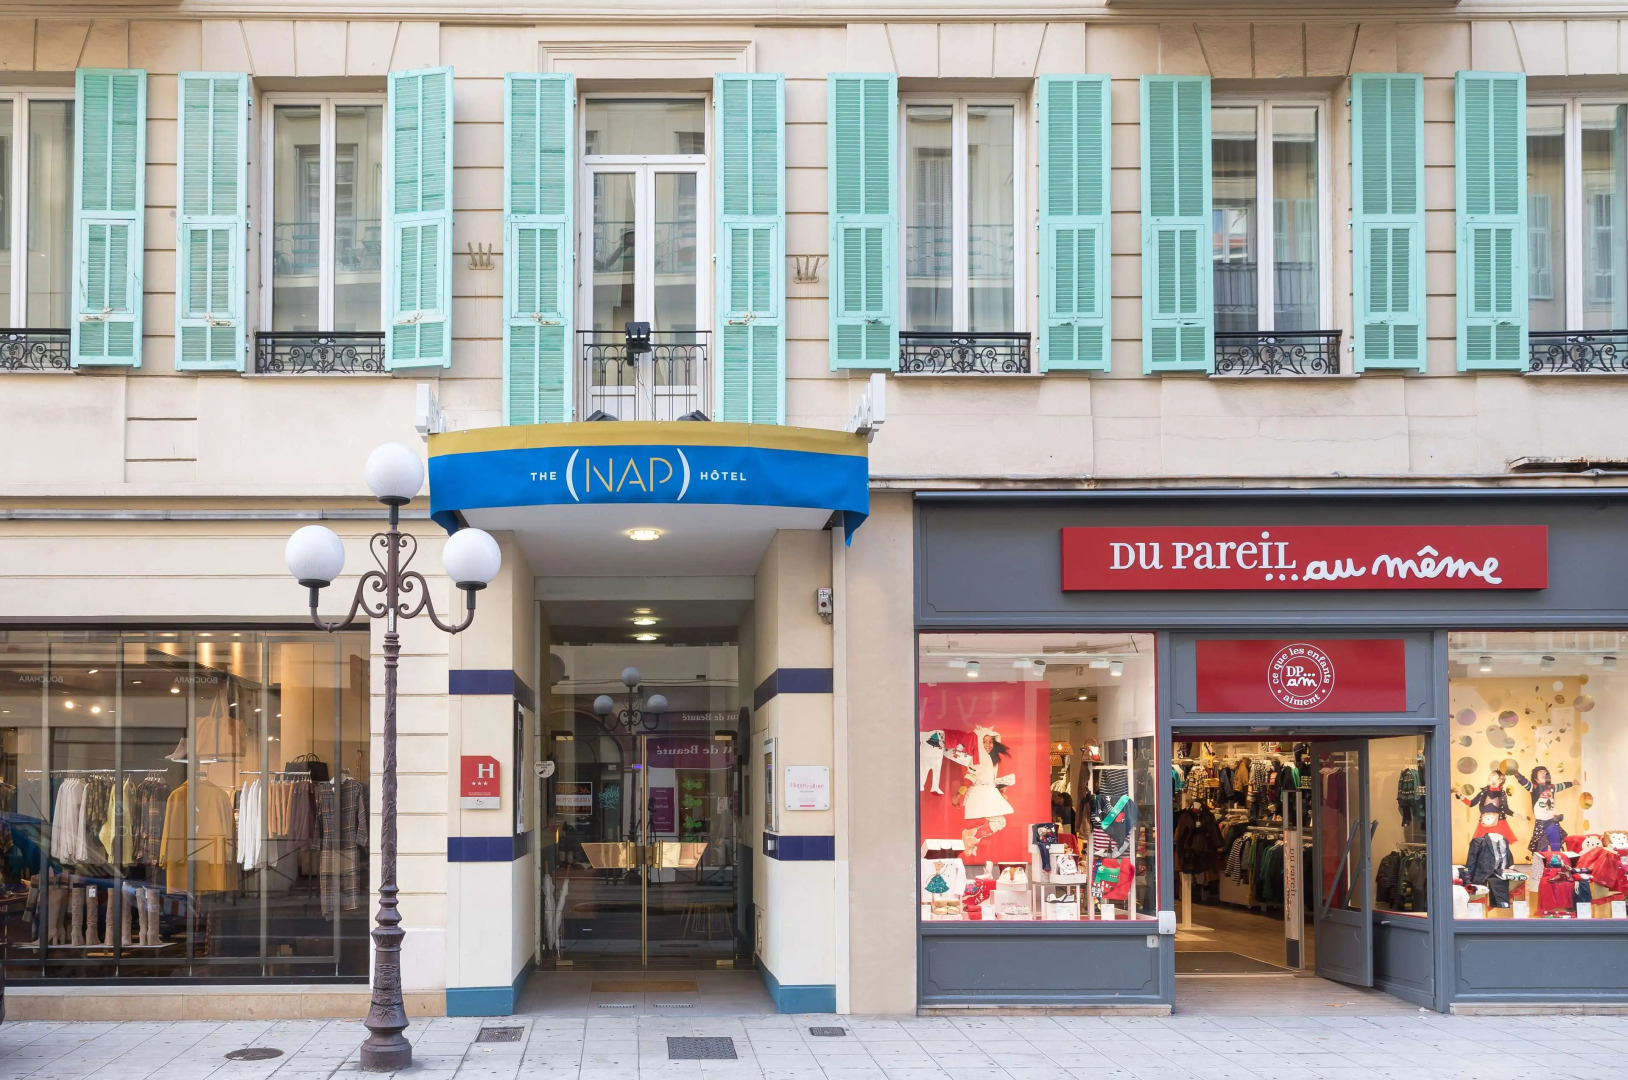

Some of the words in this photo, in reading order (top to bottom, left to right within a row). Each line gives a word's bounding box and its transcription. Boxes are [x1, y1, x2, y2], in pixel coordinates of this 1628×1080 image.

[530, 471, 557, 481] THE
[700, 469, 747, 481] HÔTEL
[1371, 545, 1503, 585] même
[1288, 648, 1305, 656] les
[1273, 653, 1289, 670] que
[1307, 649, 1332, 684] enfants
[1272, 672, 1279, 684] ce
[1286, 676, 1317, 687] am
[1283, 694, 1321, 706] aiment
[477, 763, 495, 779] H
